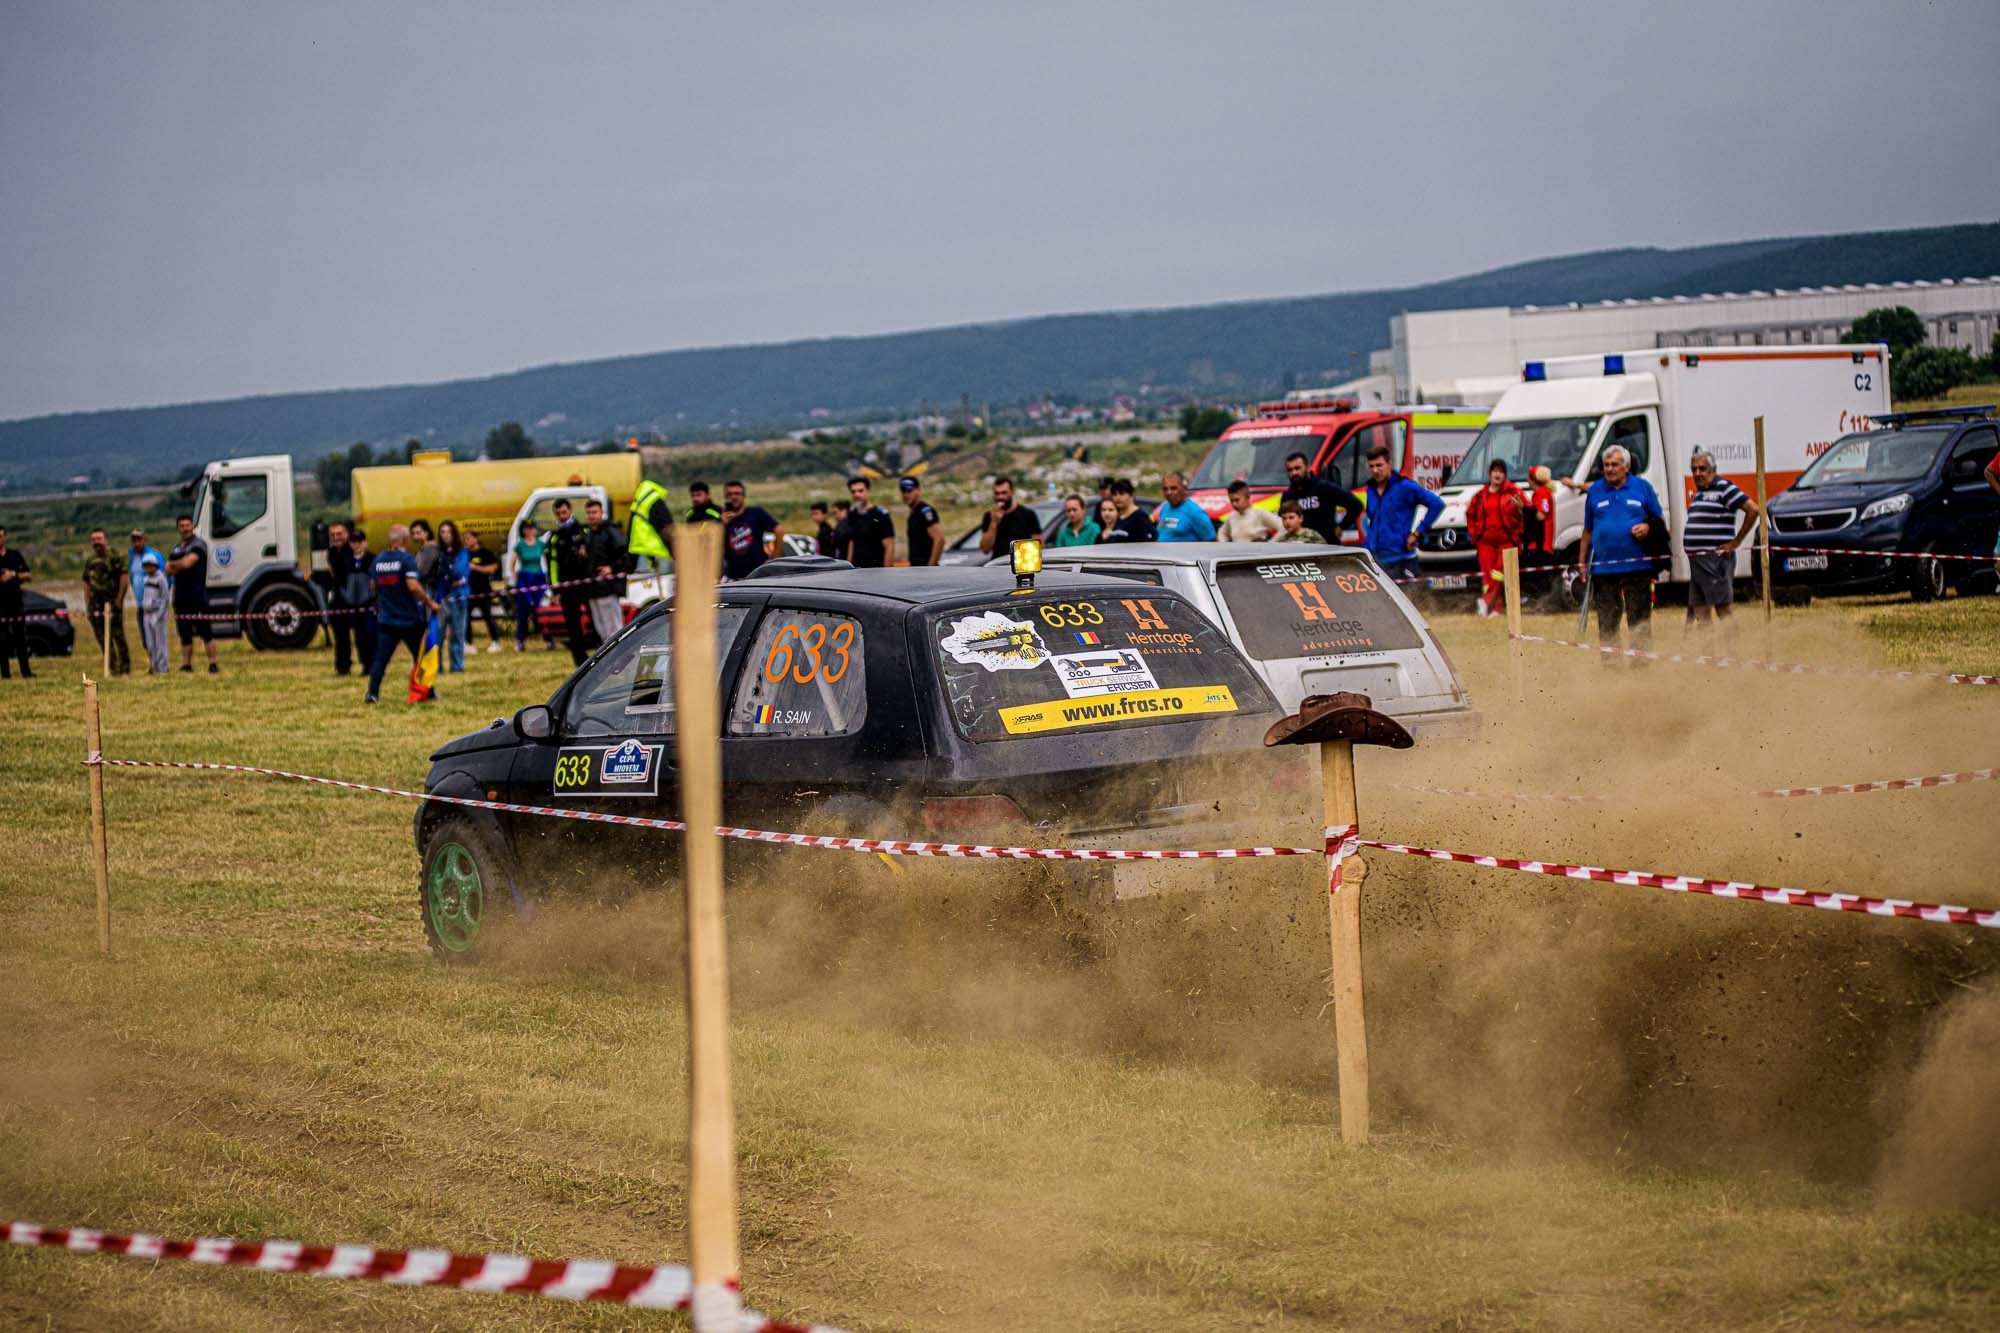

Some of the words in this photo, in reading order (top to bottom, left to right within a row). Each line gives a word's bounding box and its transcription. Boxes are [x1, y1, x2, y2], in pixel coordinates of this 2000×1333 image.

[1854, 373, 1872, 391] C2
[1850, 415, 1870, 432] 112
[1414, 454, 1463, 470] POMPIE
[1256, 562, 1322, 579] SERUS
[1335, 573, 1377, 593] 626
[1040, 602, 1104, 628] 633
[1290, 618, 1364, 637] Heritage
[1125, 632, 1195, 647] Heritage
[1302, 638, 1374, 651] advertising
[765, 623, 855, 684] 633
[1072, 677, 1105, 687] TRUCK
[1106, 674, 1144, 683] SERVICE
[1107, 680, 1155, 692] ERICSEM
[784, 710, 812, 724] SAIN
[1062, 696, 1184, 722] www.fras.ro
[1018, 713, 1044, 723] FRAS
[555, 755, 591, 787] 633
